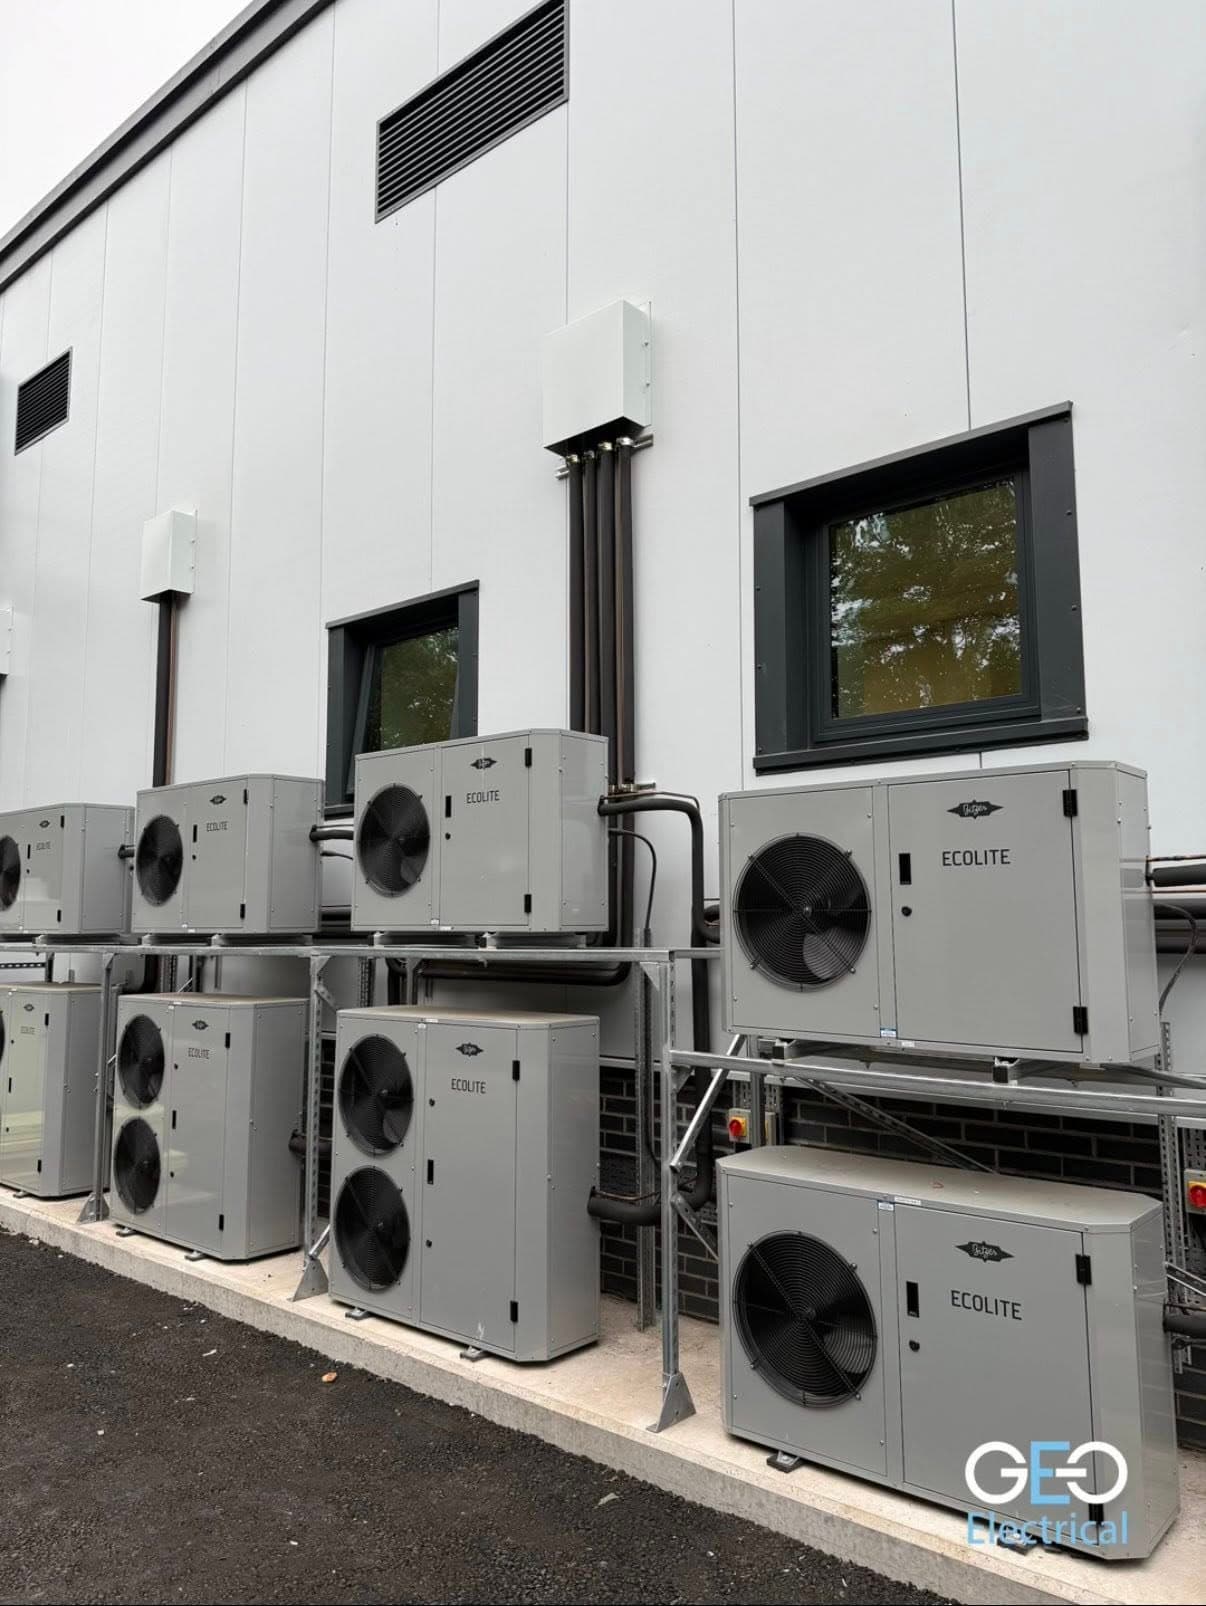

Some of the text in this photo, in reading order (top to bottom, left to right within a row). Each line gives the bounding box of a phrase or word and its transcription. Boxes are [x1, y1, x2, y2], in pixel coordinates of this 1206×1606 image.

[467, 790, 500, 804] ECOLITE
[942, 849, 1011, 867] ECOLITE
[451, 1078, 487, 1094] ECOLITE
[951, 1289, 1022, 1321] ECOLITE
